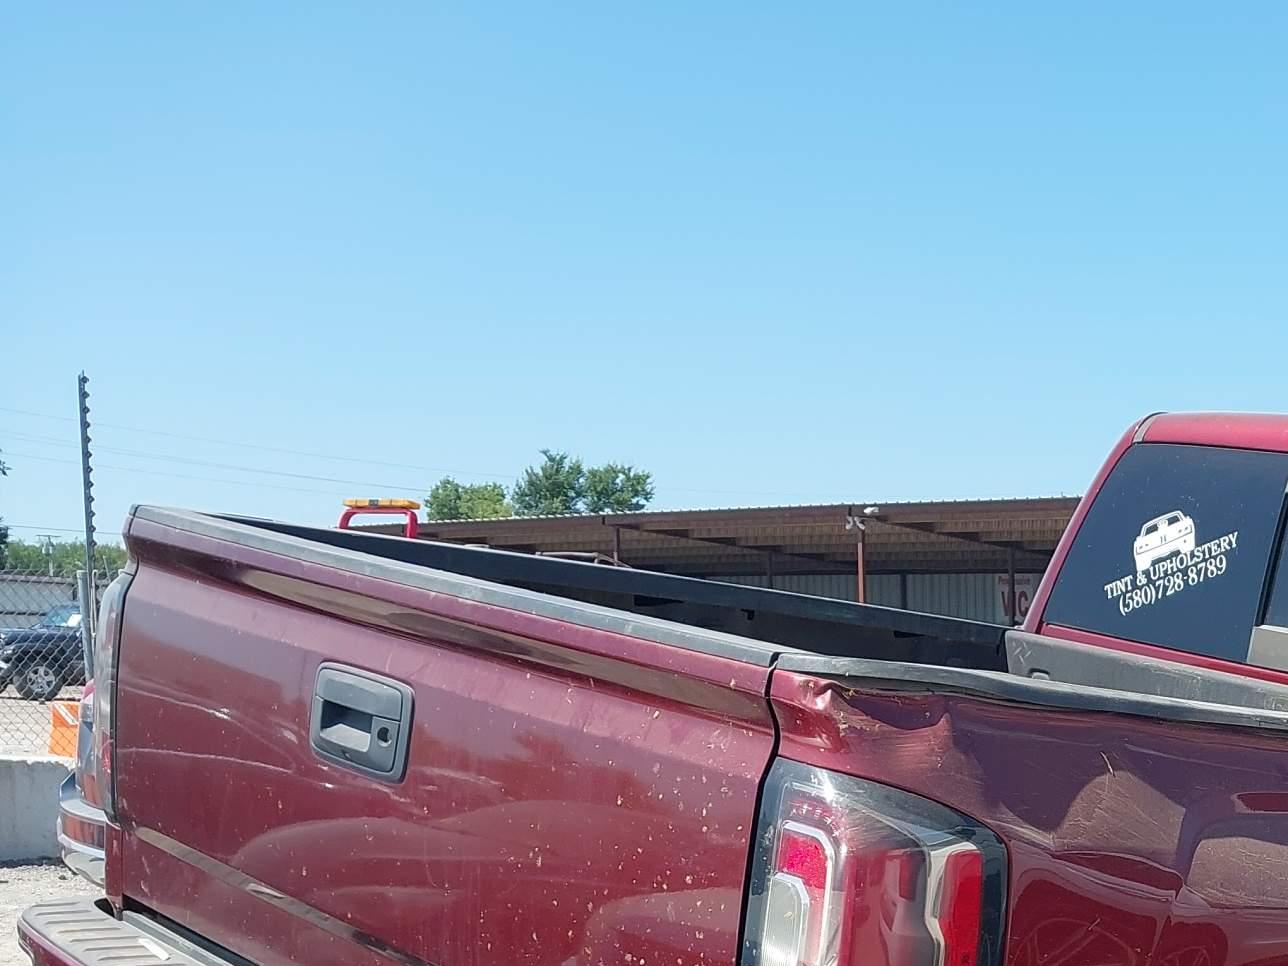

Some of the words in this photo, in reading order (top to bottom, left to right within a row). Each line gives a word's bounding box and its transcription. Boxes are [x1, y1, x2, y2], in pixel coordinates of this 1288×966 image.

[1104, 575, 1133, 599] TINT
[1136, 570, 1147, 586] &
[1149, 531, 1238, 580] UPHOLSTERY
